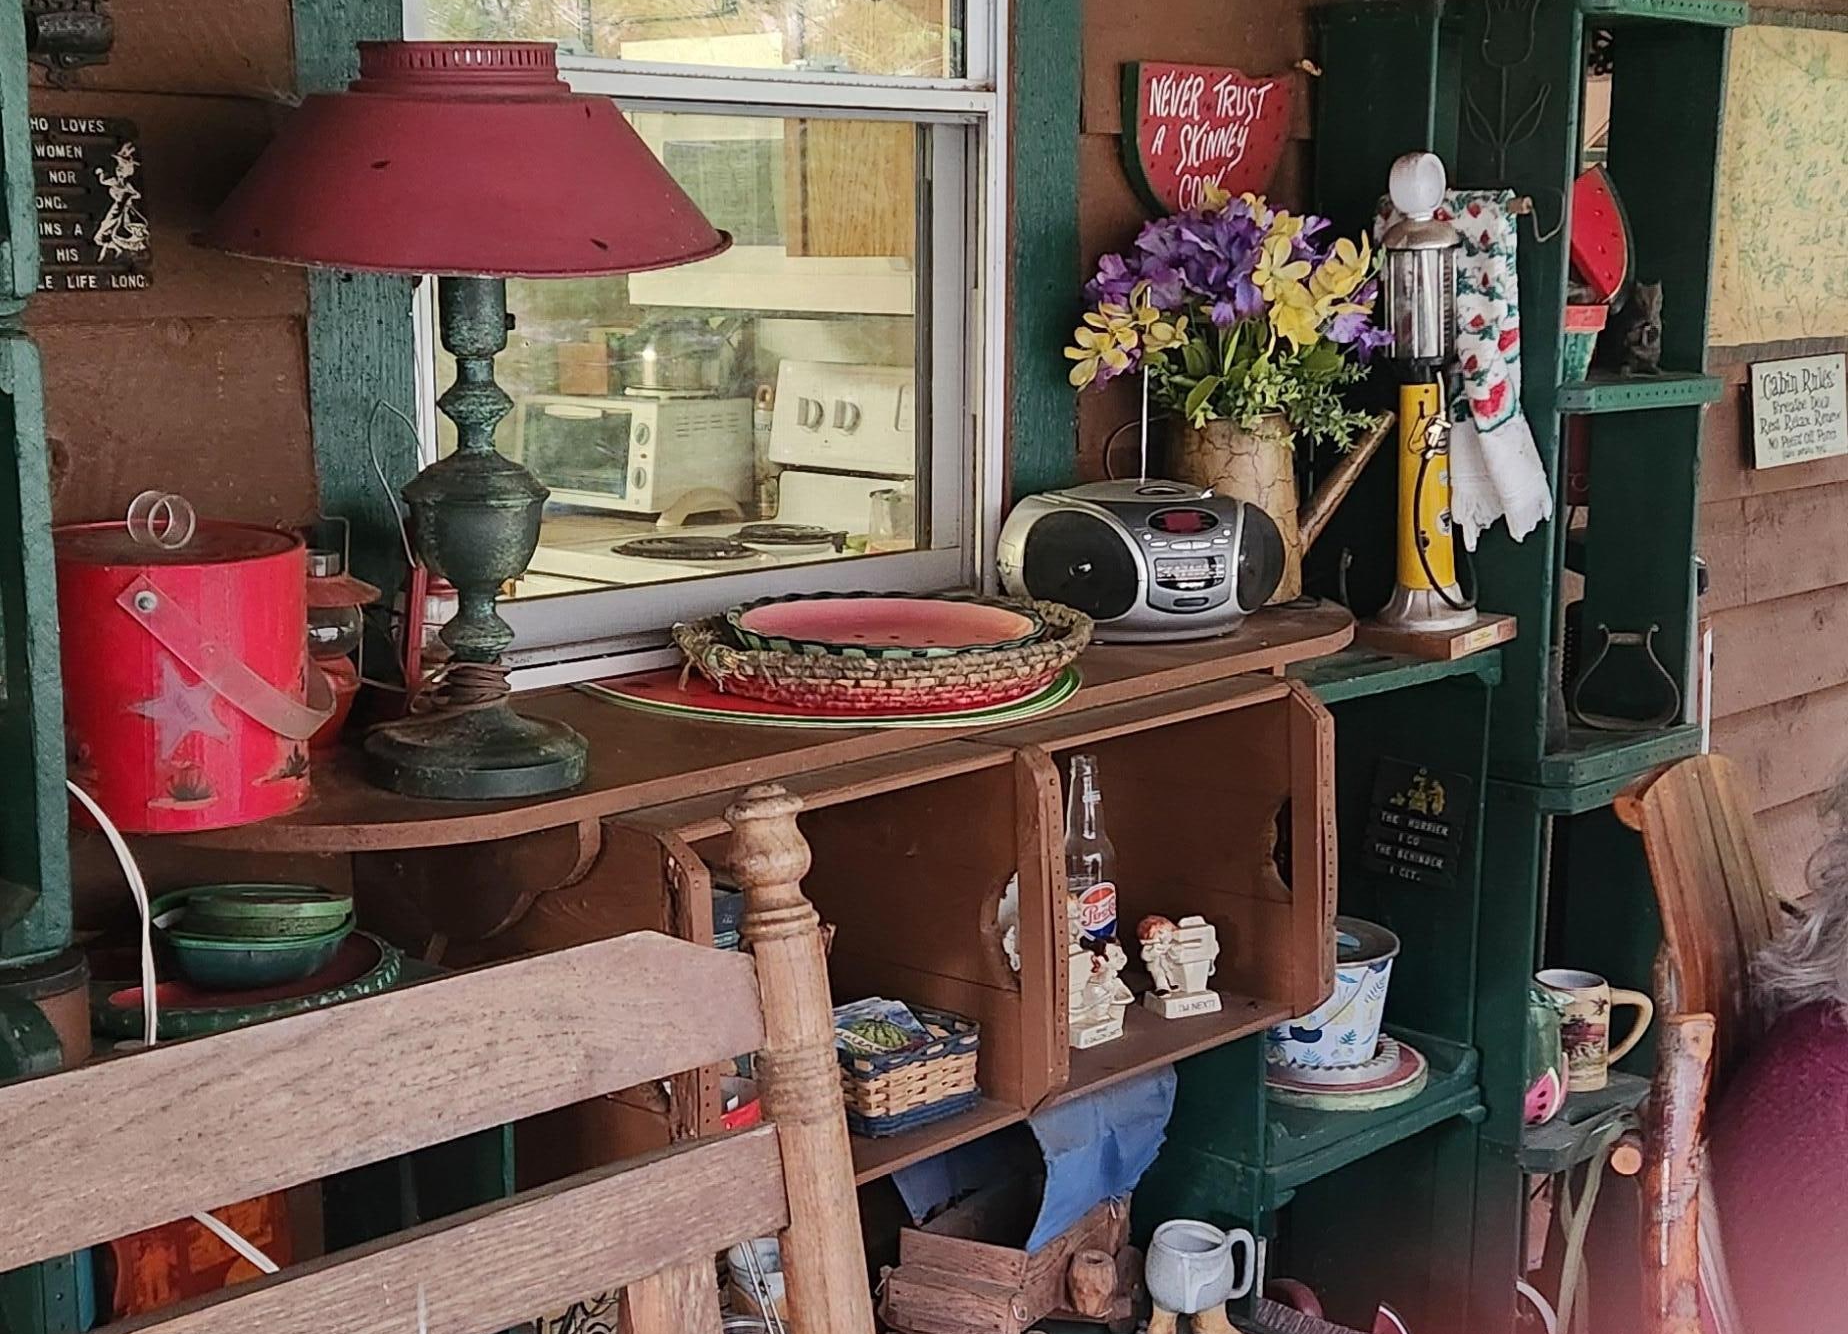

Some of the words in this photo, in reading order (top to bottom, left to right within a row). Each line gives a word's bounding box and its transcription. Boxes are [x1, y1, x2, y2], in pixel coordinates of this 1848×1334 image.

[1149, 70, 1205, 121] NEVER
[1213, 74, 1274, 125] TRUST
[29, 117, 49, 131] HO
[60, 118, 105, 133] LOVES
[1151, 125, 1167, 156] A
[34, 144, 83, 158] WOMEN
[48, 170, 77, 184] NOR
[74, 223, 83, 236] A
[56, 248, 79, 262] HIS
[66, 275, 97, 289] LIFE
[1381, 810, 1400, 824] THE
[1374, 843, 1391, 856] THE
